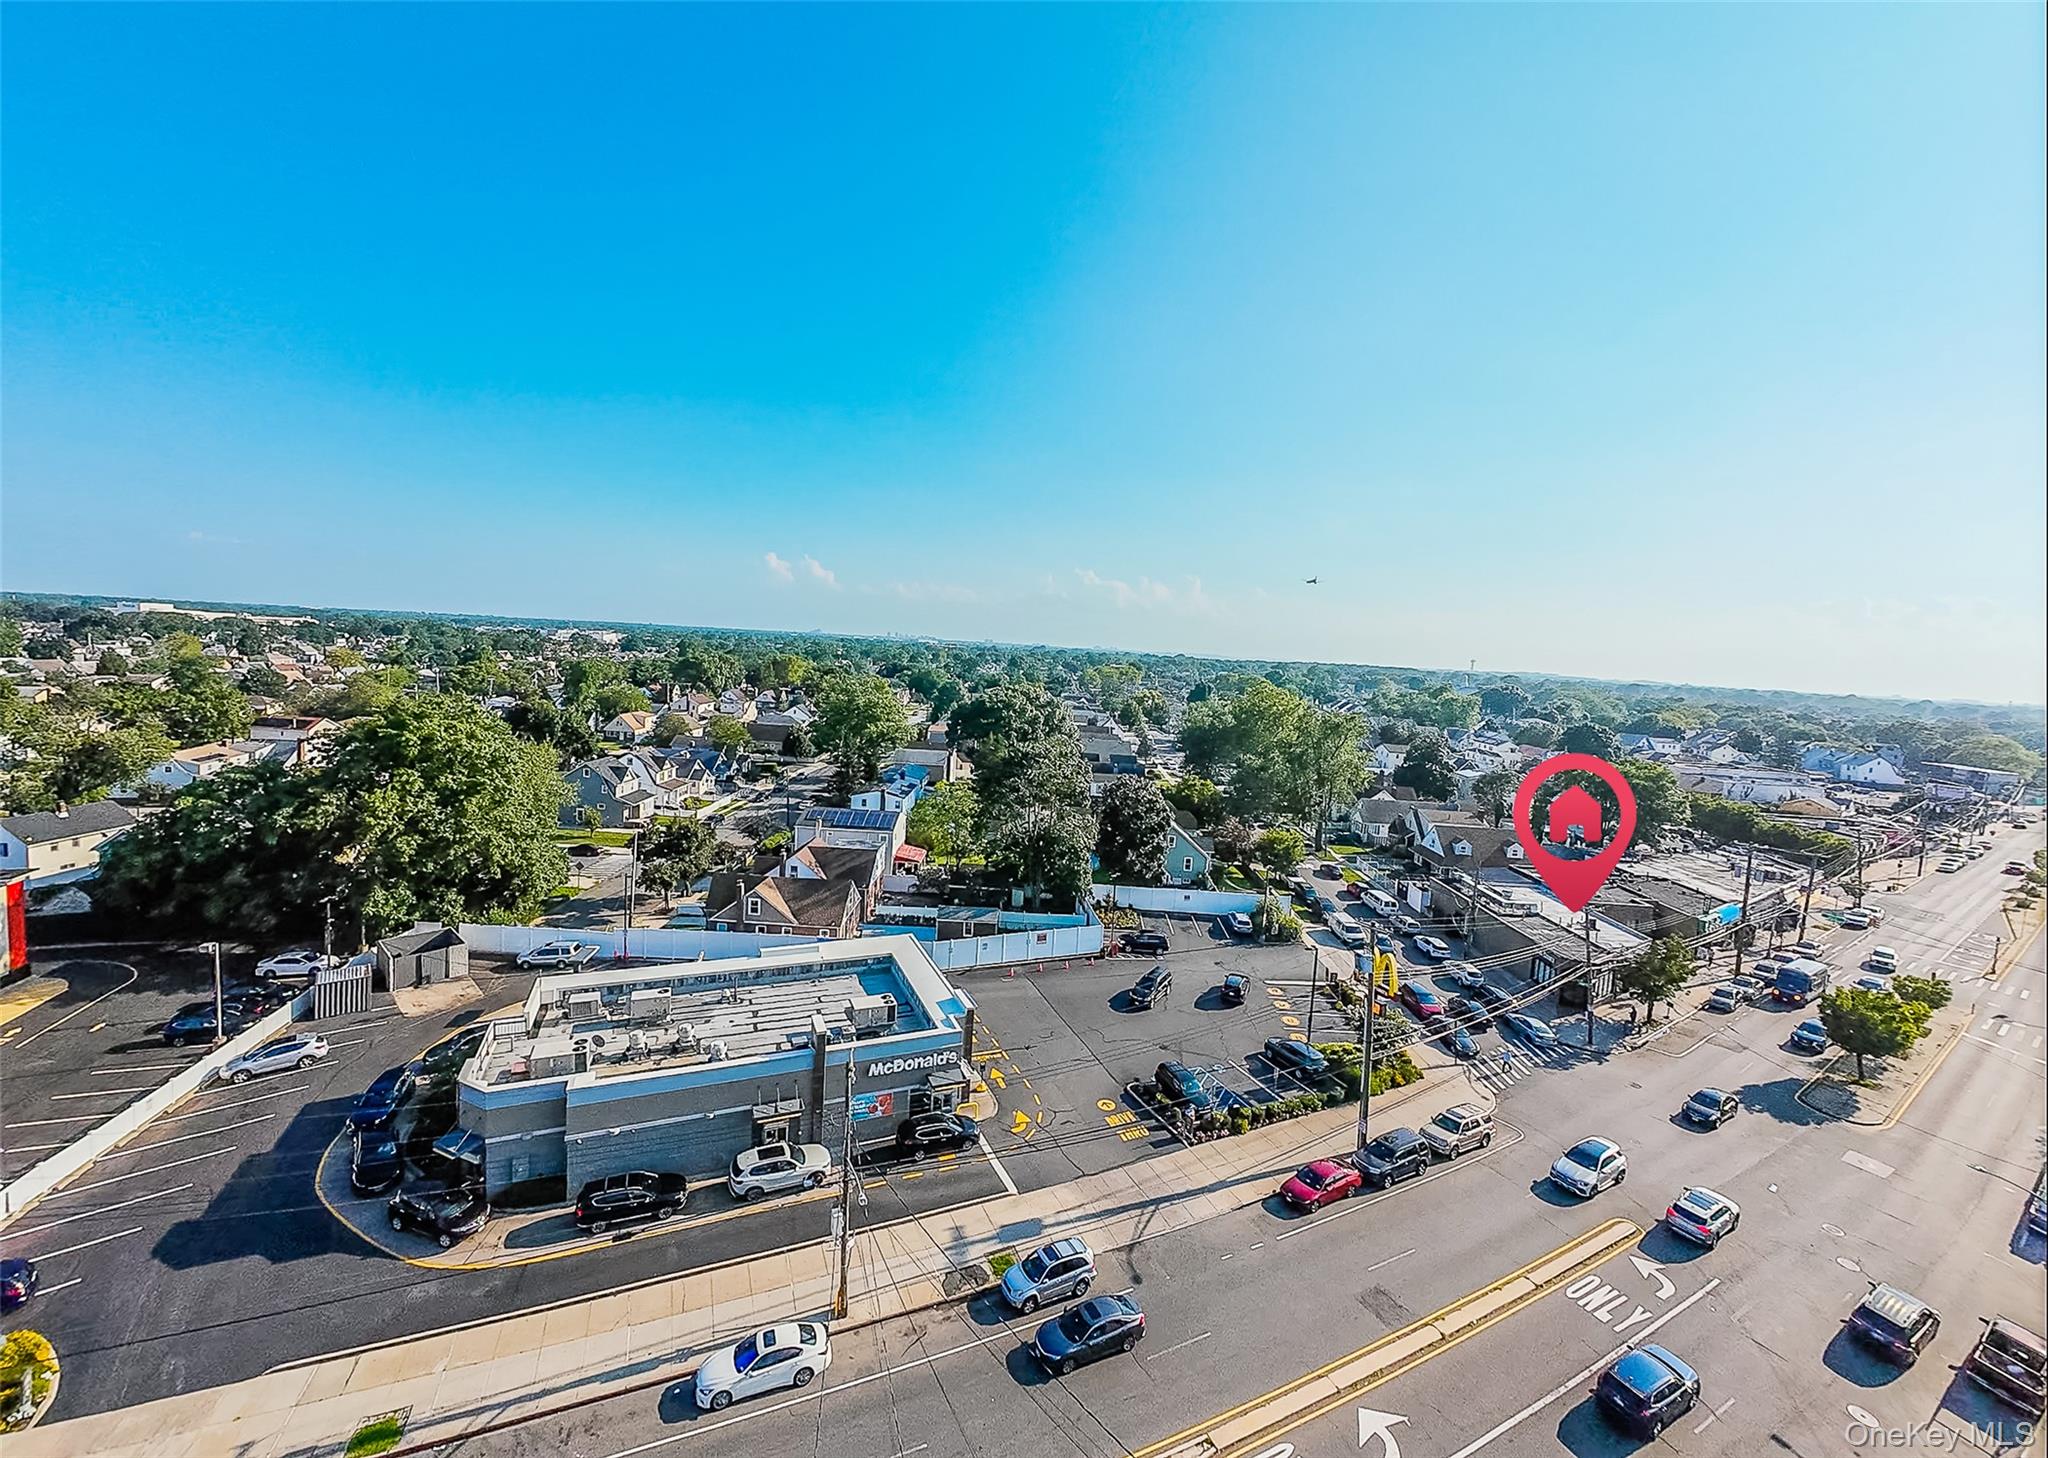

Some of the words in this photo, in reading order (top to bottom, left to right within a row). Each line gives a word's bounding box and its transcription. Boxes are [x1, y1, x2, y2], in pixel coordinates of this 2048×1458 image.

[868, 1051, 961, 1077] McDonald's
[1116, 1125, 1150, 1142] THRU
[1565, 1274, 1653, 1333] ONLY
